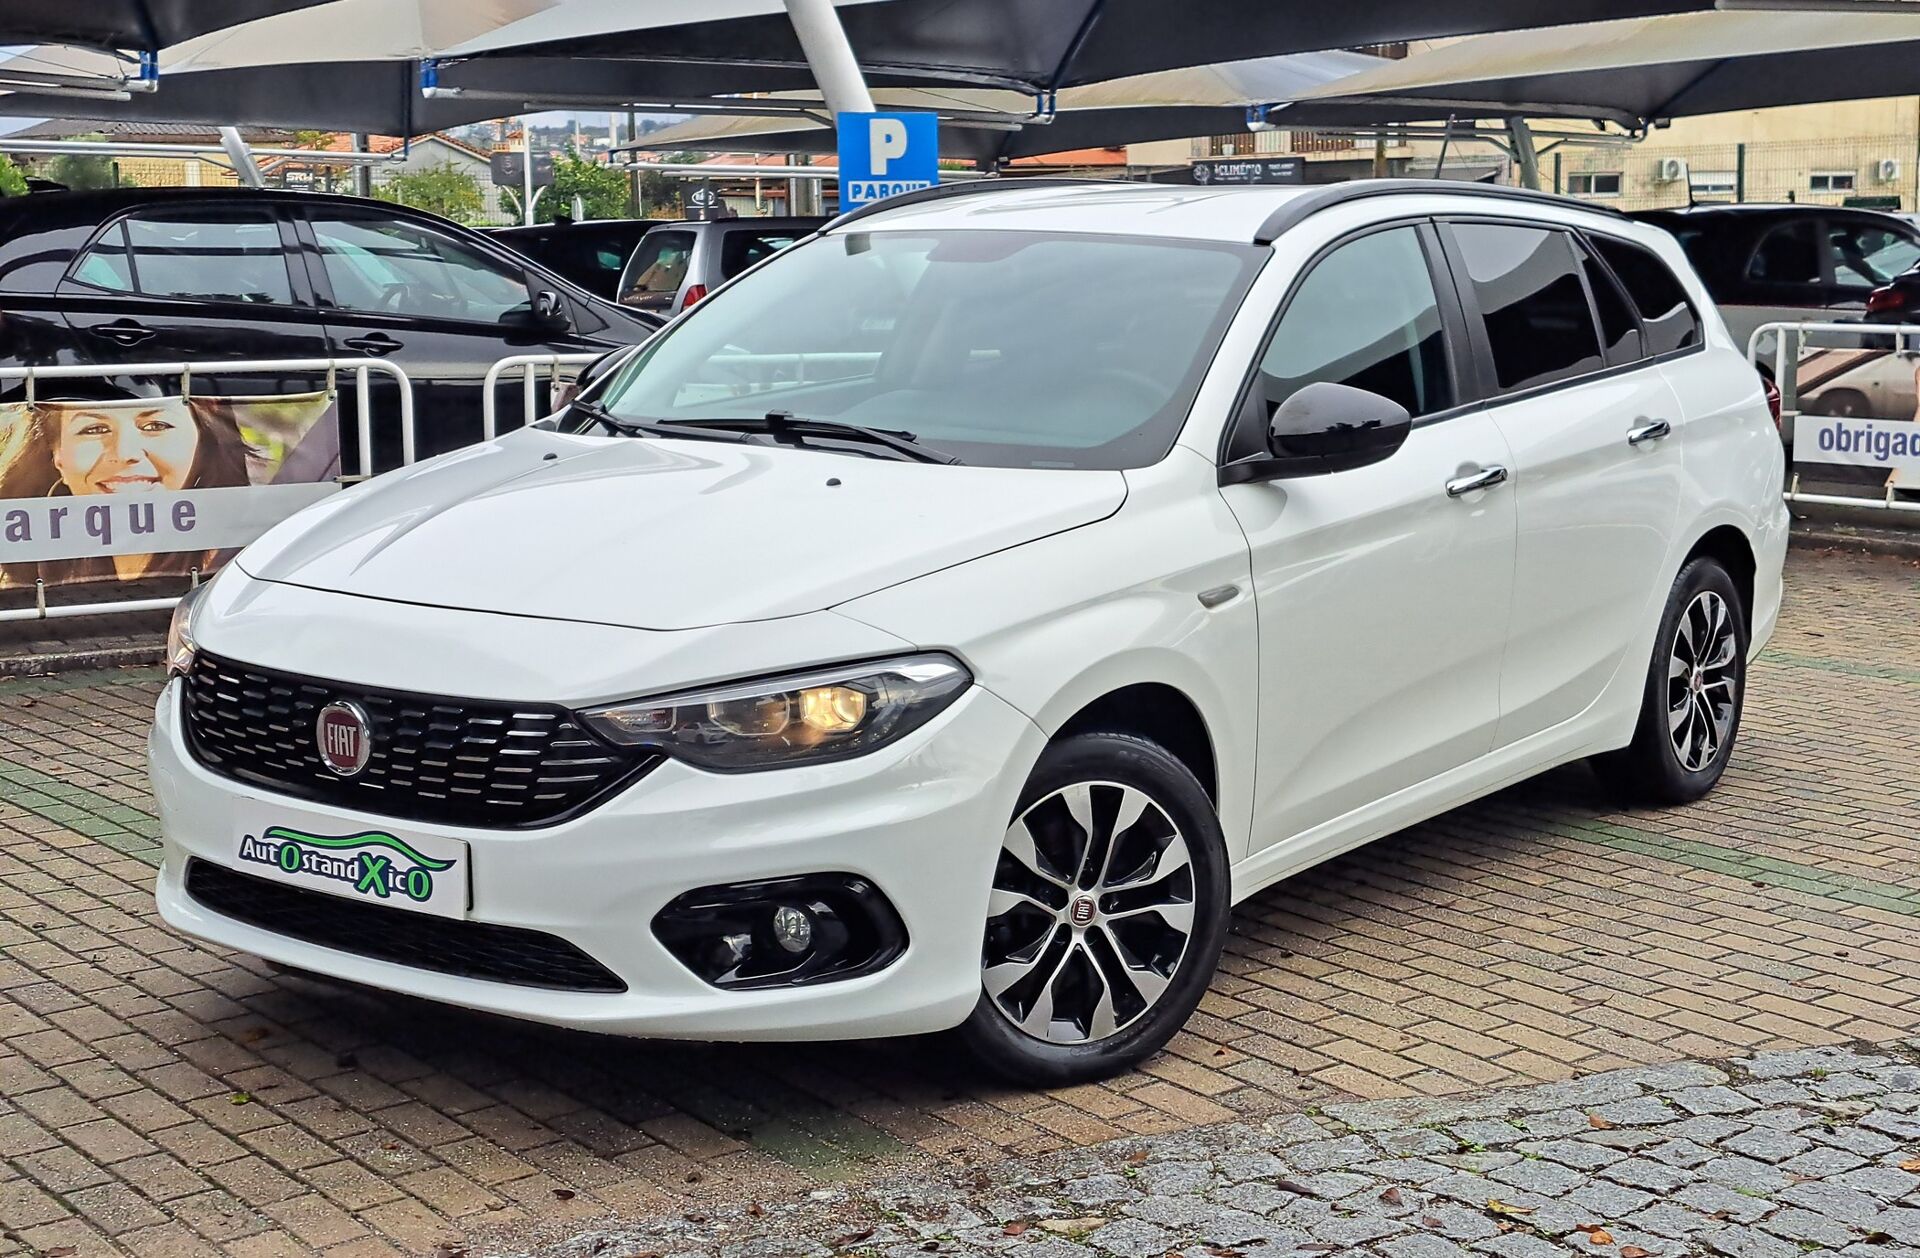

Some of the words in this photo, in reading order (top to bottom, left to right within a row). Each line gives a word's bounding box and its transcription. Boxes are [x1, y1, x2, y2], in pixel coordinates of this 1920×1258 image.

[869, 118, 908, 175] P
[851, 183, 929, 200] PARQ
[5, 500, 196, 546] arque
[327, 722, 357, 757] FIAT
[241, 836, 431, 900] AutOstandXicO
[1076, 900, 1090, 919] FIAT
